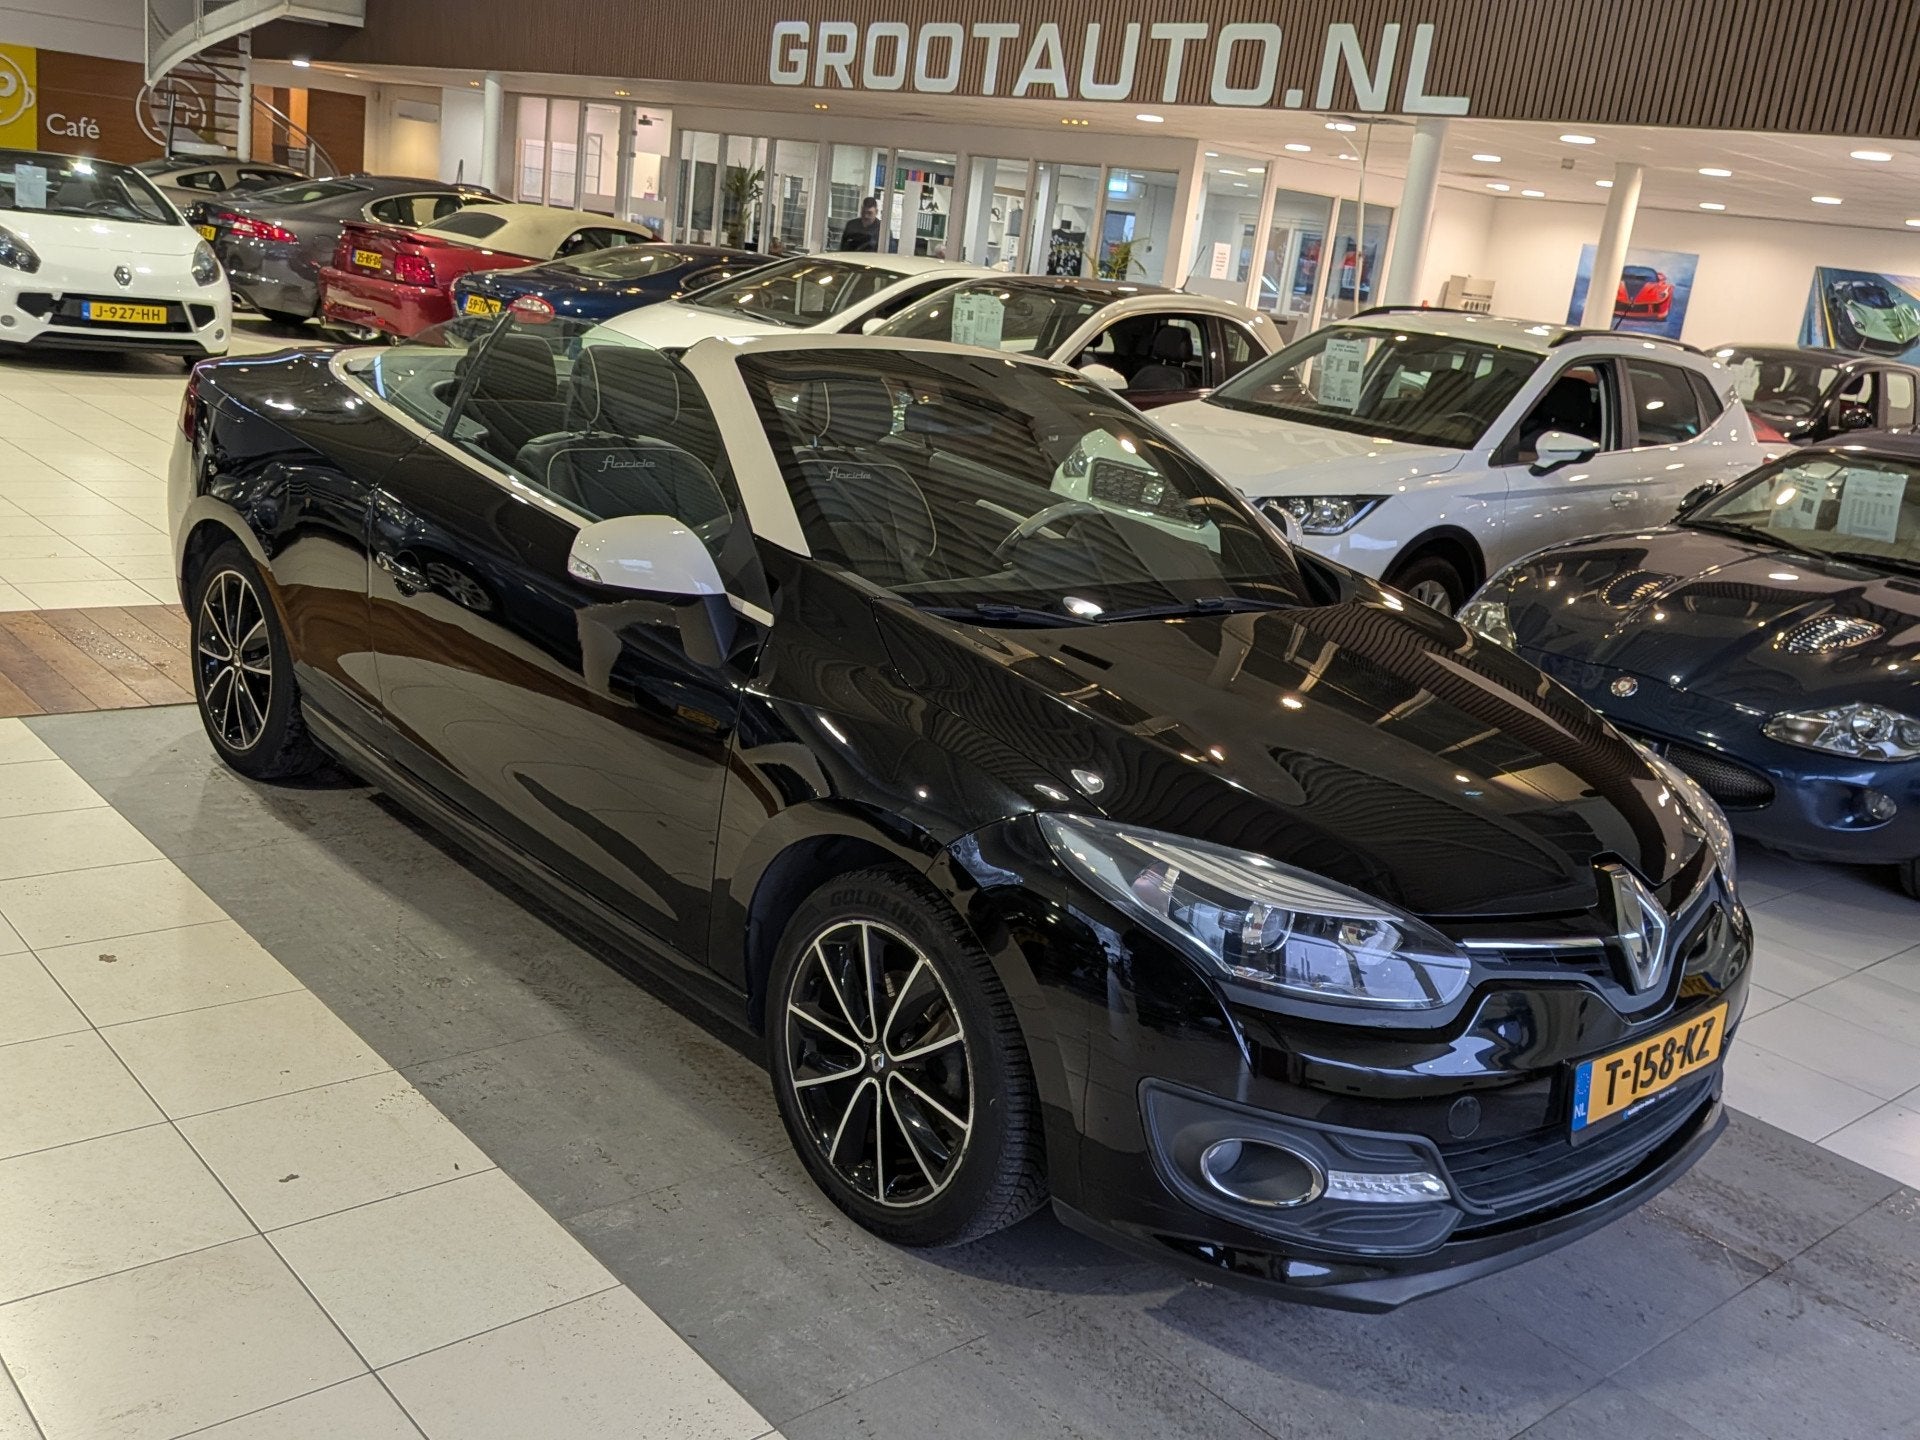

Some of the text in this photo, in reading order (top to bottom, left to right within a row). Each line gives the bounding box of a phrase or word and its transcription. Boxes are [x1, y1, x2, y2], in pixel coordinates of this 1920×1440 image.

[769, 20, 1471, 116] GROOTAUTO.NL
[46, 113, 100, 140] Café
[95, 306, 161, 321] J-927-HH
[1605, 1016, 1717, 1107] T-158-KZ
[1573, 1102, 1587, 1119] NL
